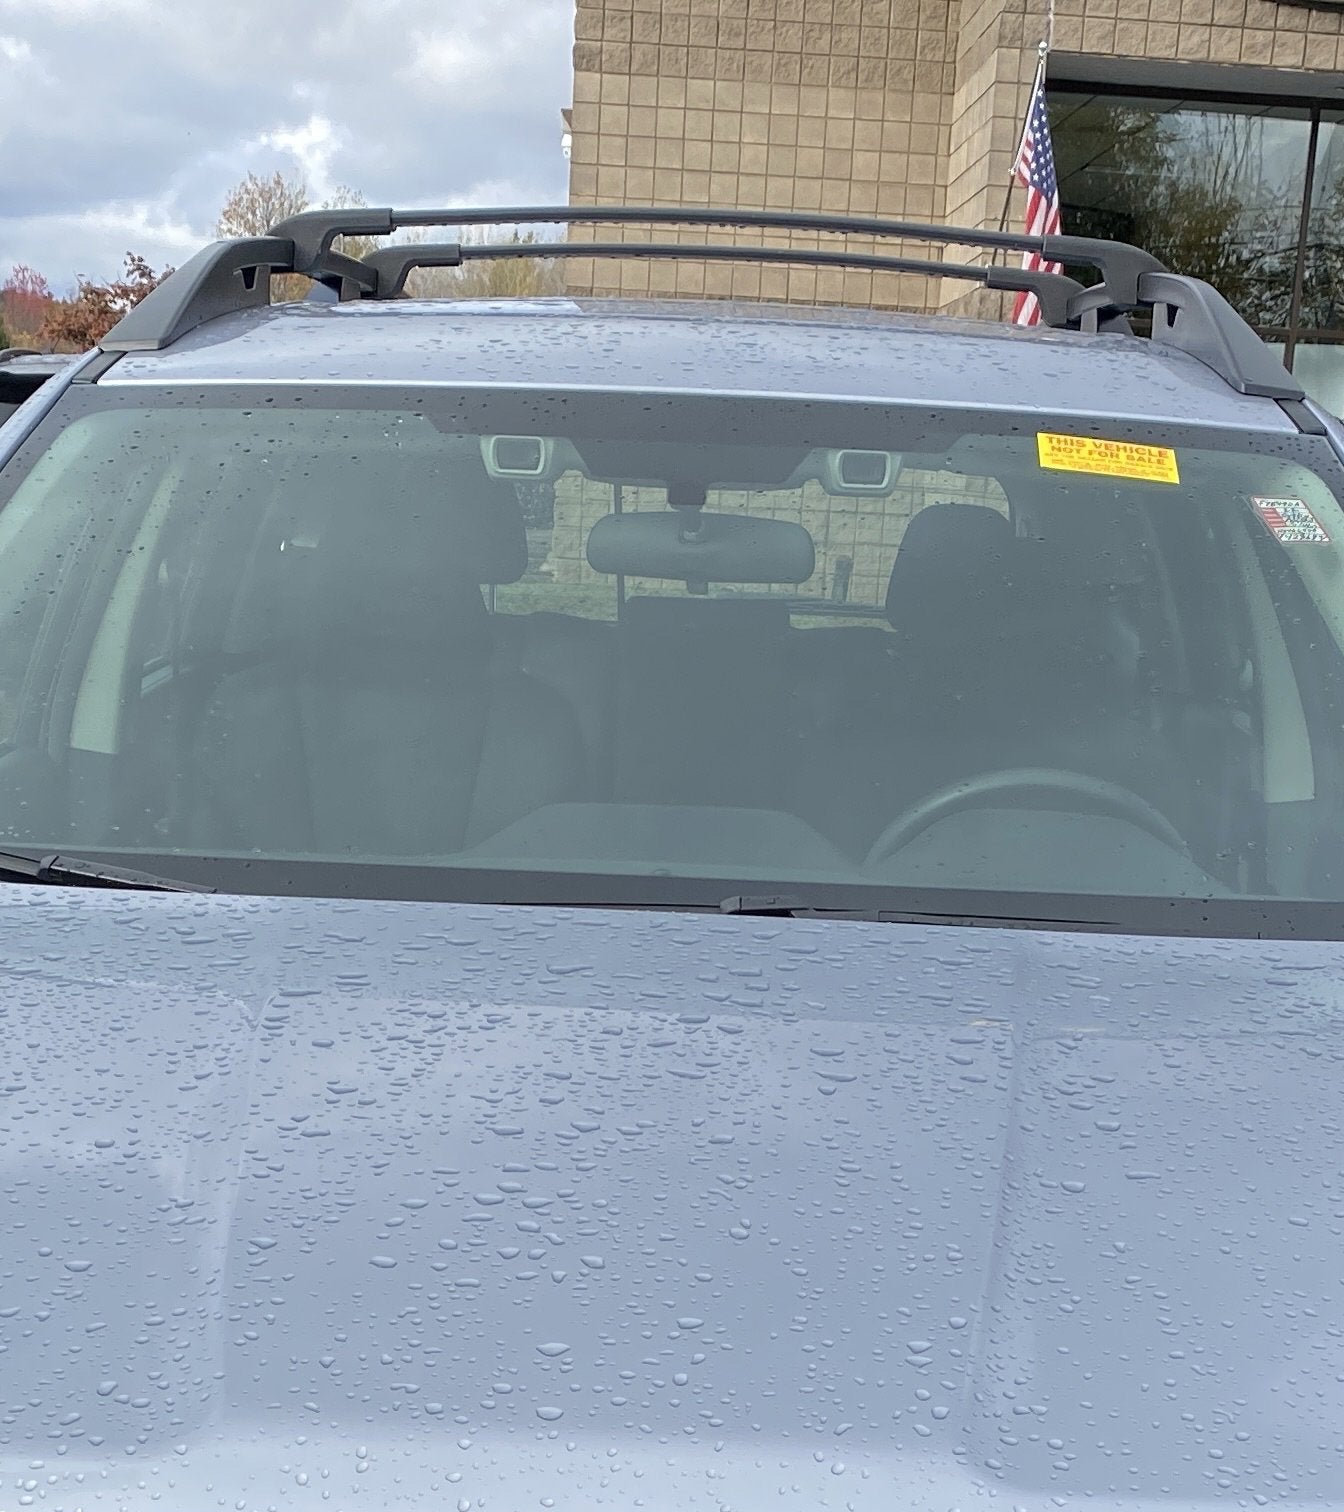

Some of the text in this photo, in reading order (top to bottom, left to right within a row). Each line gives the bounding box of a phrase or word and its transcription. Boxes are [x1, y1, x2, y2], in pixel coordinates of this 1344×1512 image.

[1046, 435, 1170, 459] THIS VEHICLE
[1050, 445, 1082, 455] NOT
[1088, 449, 1121, 460] FOR
[1126, 454, 1167, 466] SALE
